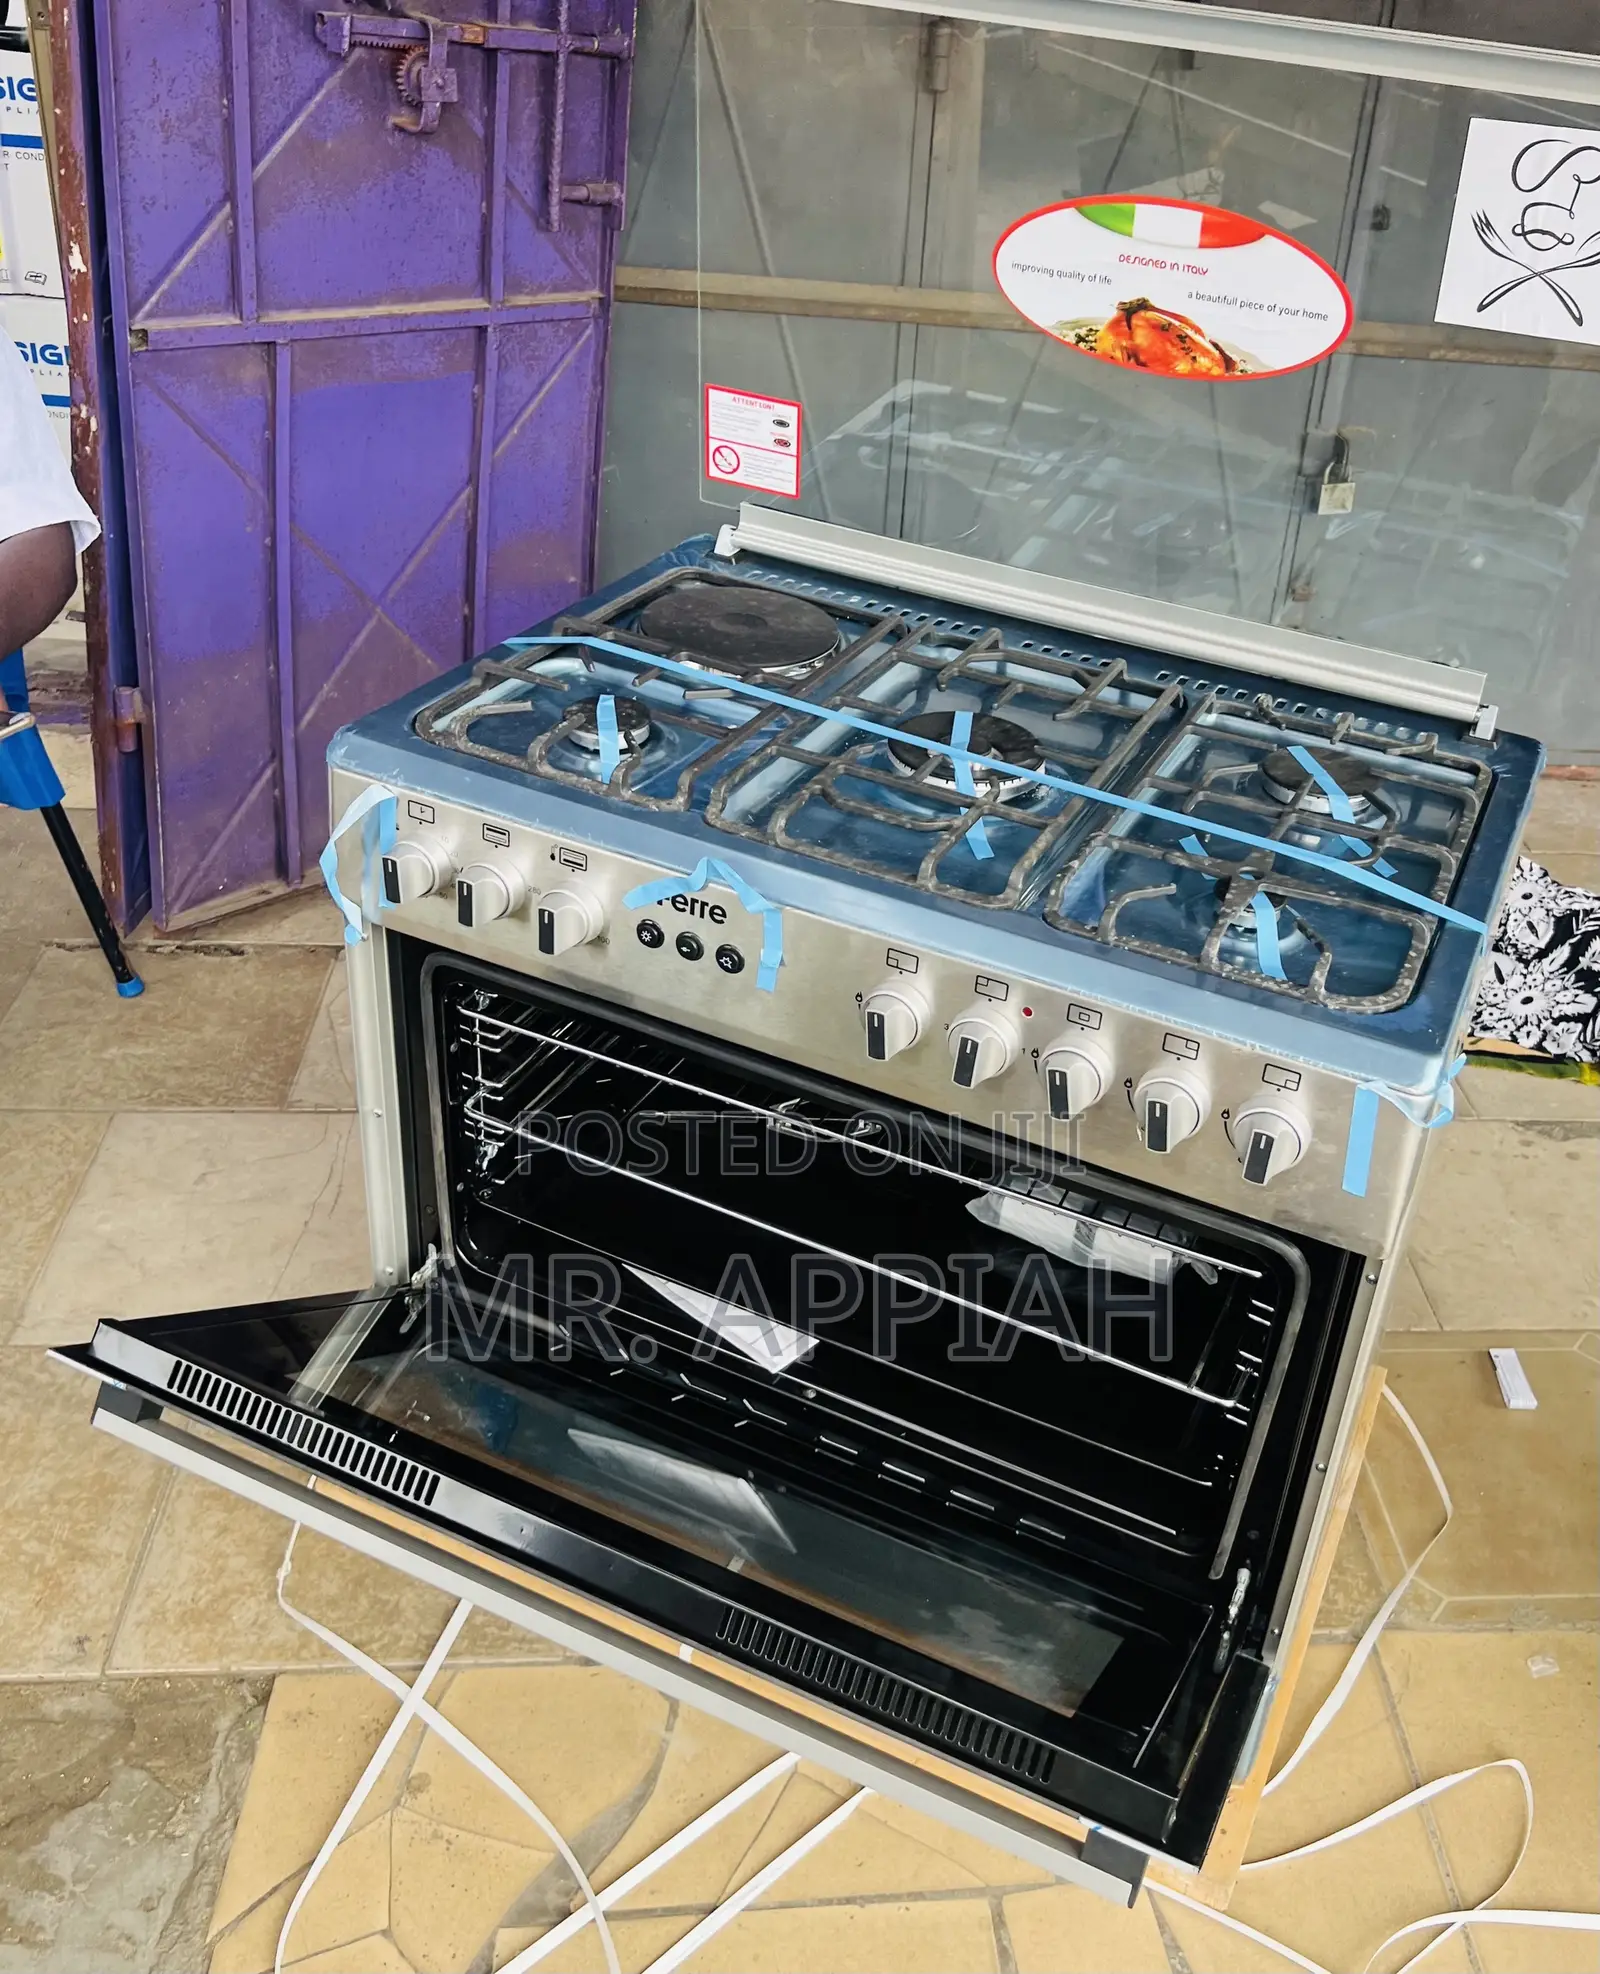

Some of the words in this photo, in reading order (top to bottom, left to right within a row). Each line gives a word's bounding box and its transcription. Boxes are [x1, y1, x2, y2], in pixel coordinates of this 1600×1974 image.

[1011, 260, 1054, 278] improving
[1056, 267, 1086, 283] quality
[1087, 272, 1097, 283] of
[1098, 274, 1112, 286] life
[1118, 254, 1167, 270] DESIGNED
[1169, 262, 1180, 272] IN
[1182, 263, 1209, 276] ITALY
[1195, 290, 1238, 306] beautifull
[1239, 298, 1265, 311] piece
[1266, 303, 1277, 313] of
[1278, 306, 1301, 317] your
[1302, 308, 1329, 321] home
